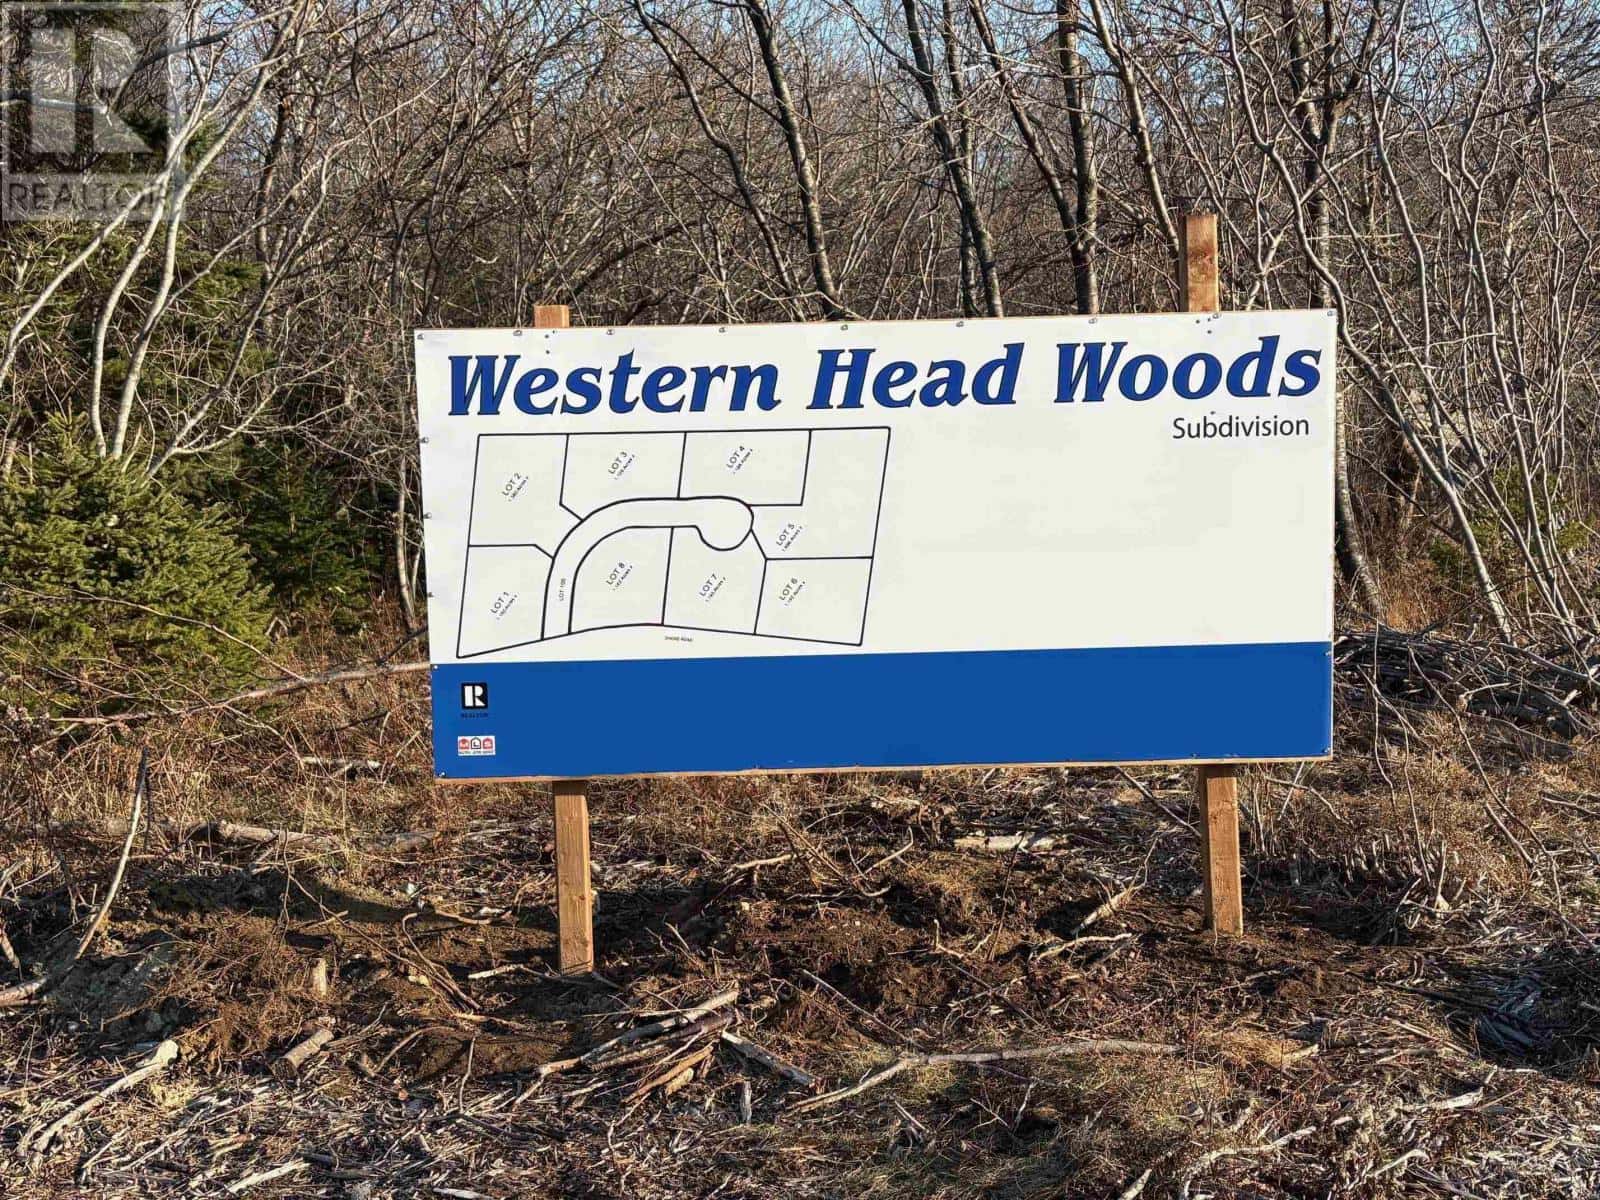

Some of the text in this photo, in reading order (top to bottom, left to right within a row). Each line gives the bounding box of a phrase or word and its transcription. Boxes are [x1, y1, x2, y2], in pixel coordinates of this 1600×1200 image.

[448, 335, 1322, 415] Western Head Woods
[1172, 415, 1310, 439] Subdivision
[607, 456, 622, 474] LOT
[726, 450, 740, 468] LOT
[501, 478, 515, 496] LOT
[775, 528, 789, 546] LOT
[606, 567, 620, 585] LOT
[699, 579, 713, 597] LOT
[778, 583, 792, 601] LOT
[490, 597, 504, 614] LOT
